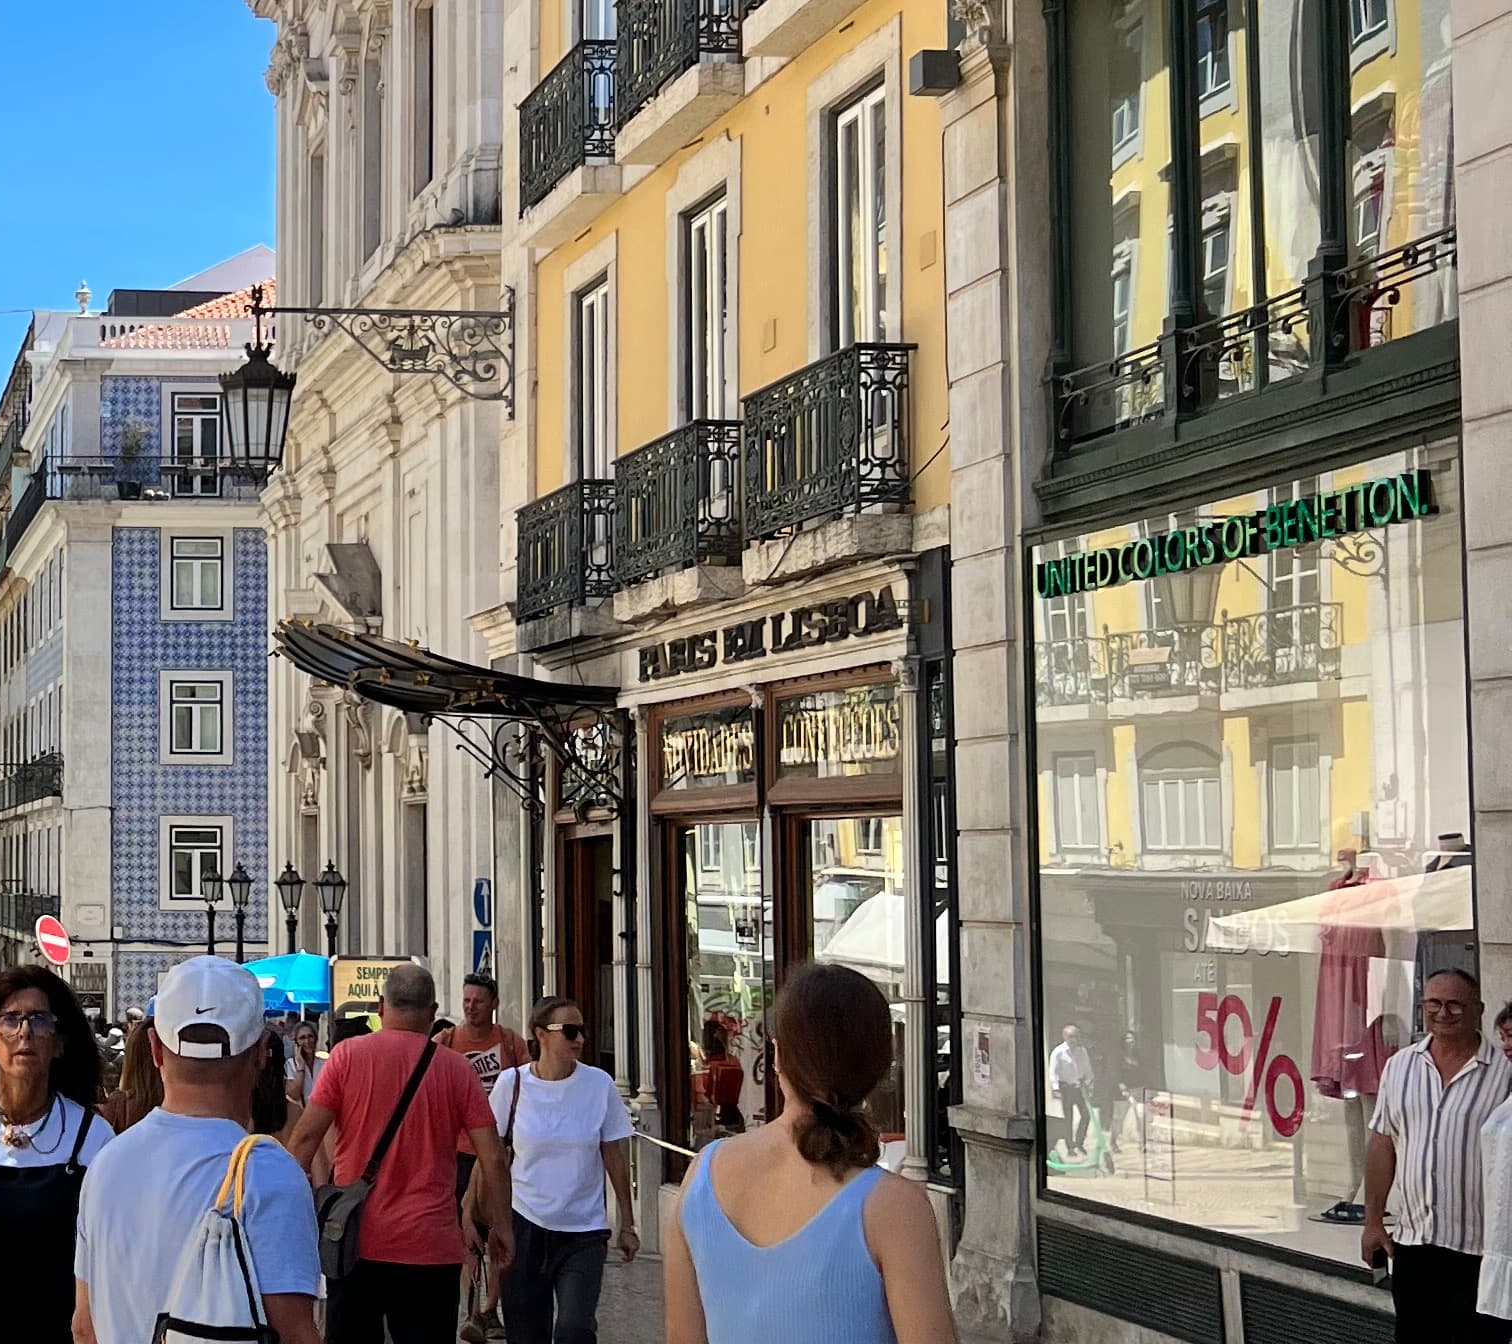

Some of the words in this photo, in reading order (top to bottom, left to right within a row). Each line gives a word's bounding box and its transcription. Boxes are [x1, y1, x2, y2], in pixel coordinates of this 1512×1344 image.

[1037, 546, 1113, 599] UNITED
[1118, 521, 1215, 581] COLORS
[1220, 513, 1259, 560] OF
[637, 629, 718, 684] PARIS
[770, 584, 904, 655] LISBOA
[1180, 880, 1214, 901] NOVA
[1215, 880, 1253, 901] BAIXA
[1183, 906, 1291, 957] SALDOS
[356, 966, 392, 980] SEMPR
[1192, 959, 1217, 984] ATÉ
[347, 983, 371, 999] AQUI
[1194, 991, 1306, 1138] 50%
